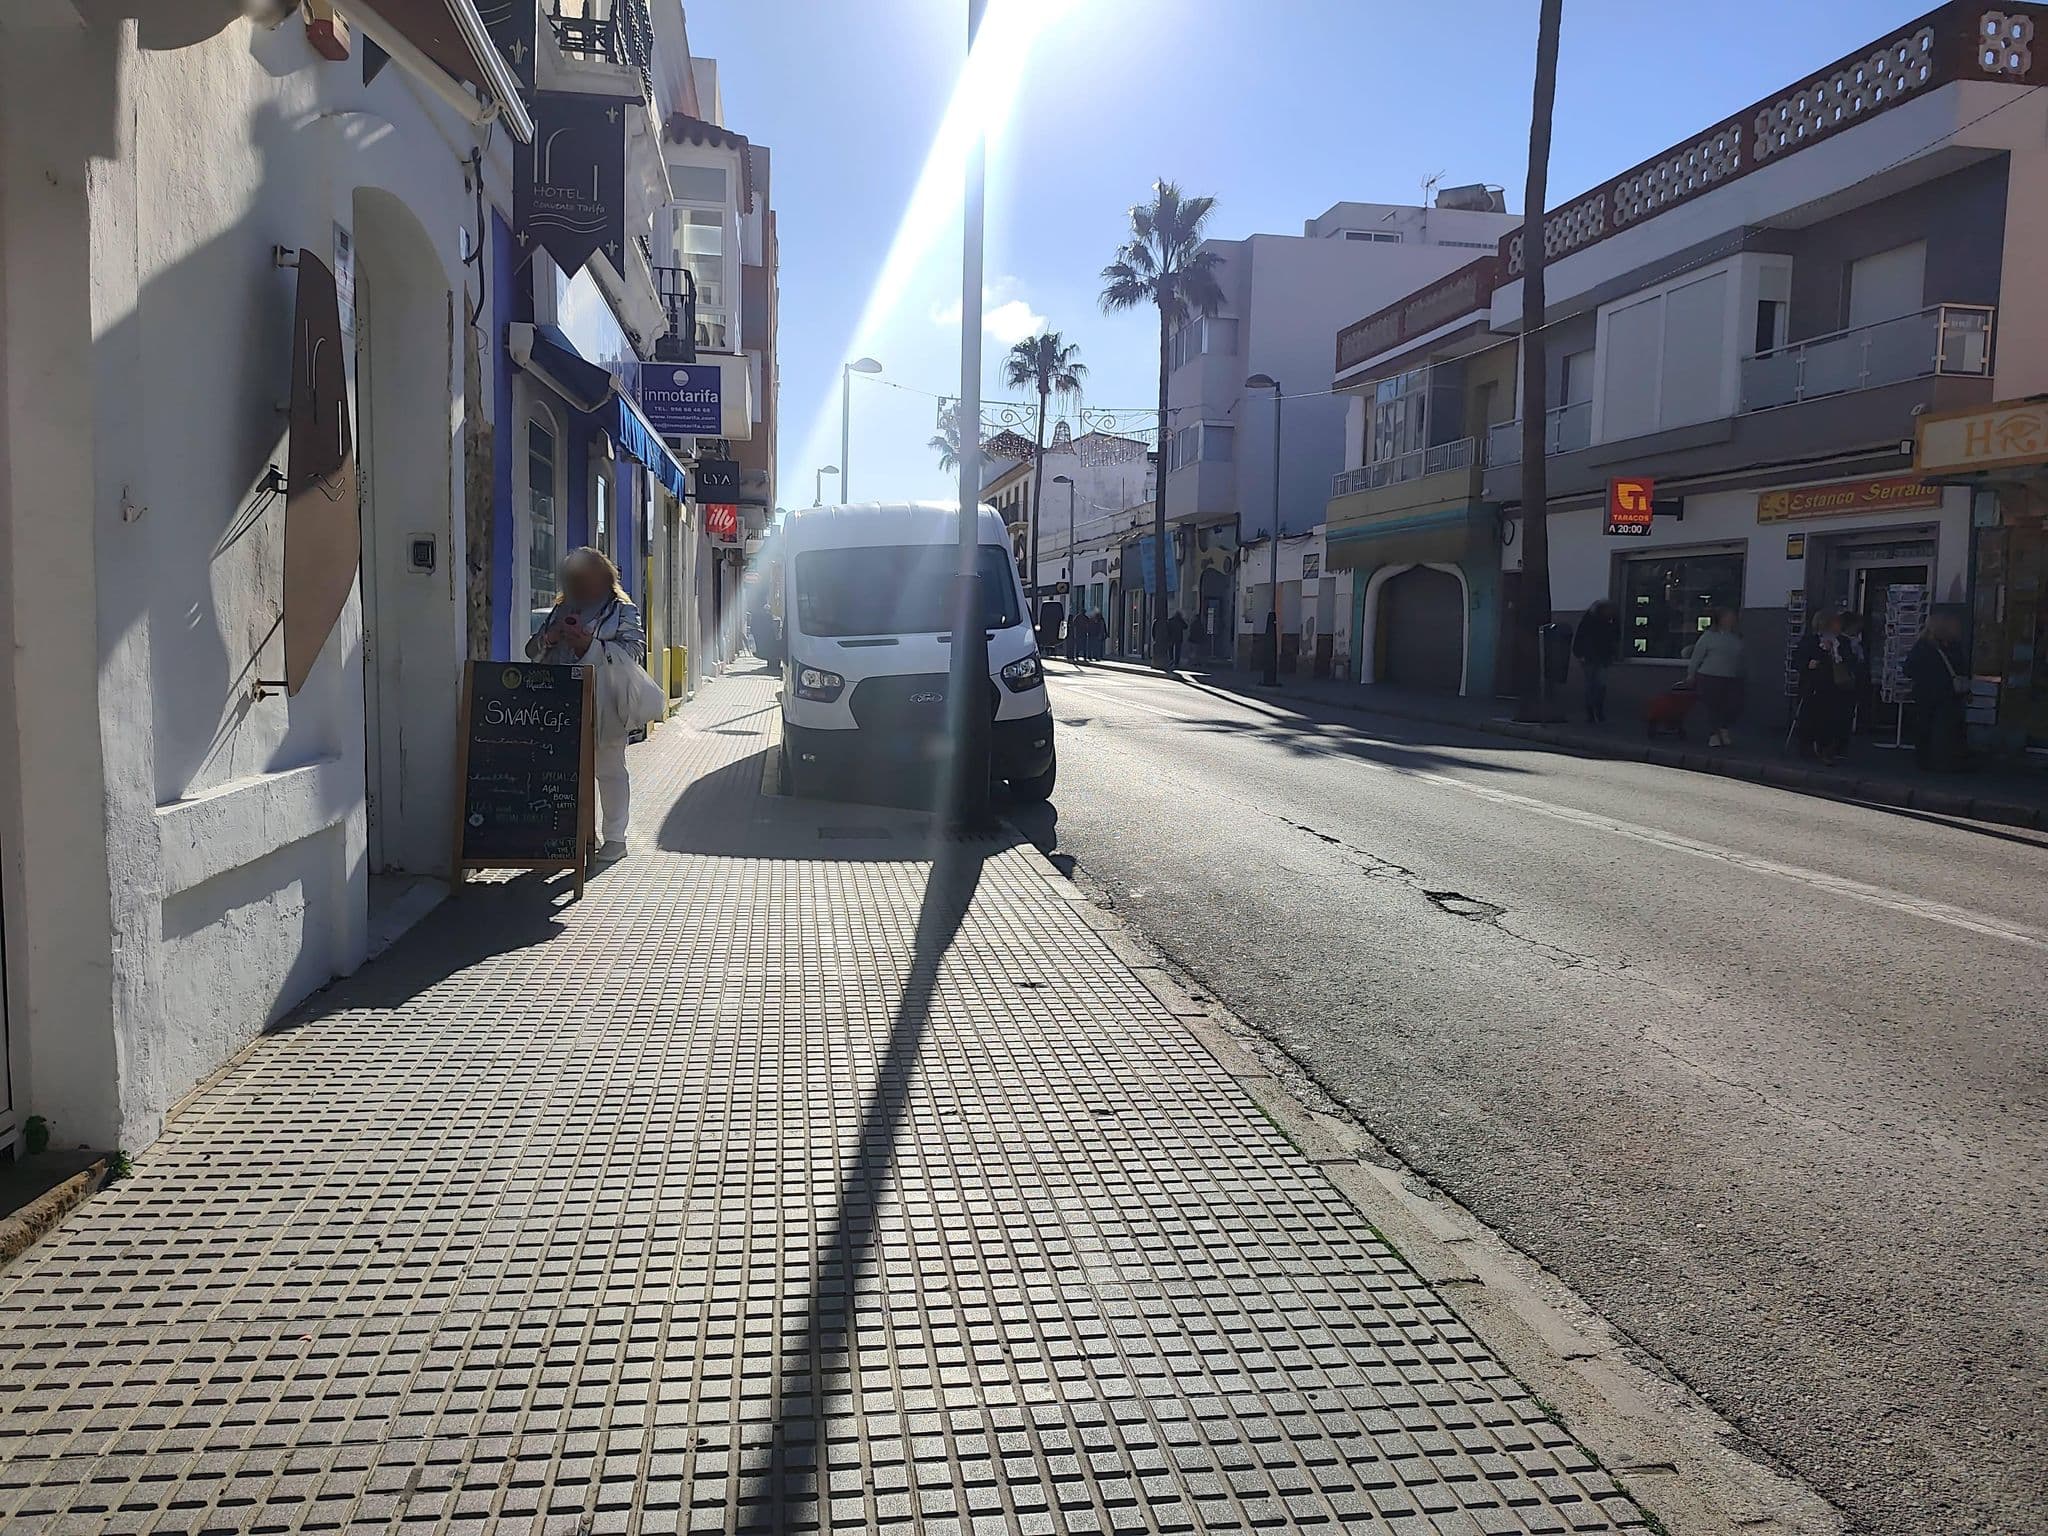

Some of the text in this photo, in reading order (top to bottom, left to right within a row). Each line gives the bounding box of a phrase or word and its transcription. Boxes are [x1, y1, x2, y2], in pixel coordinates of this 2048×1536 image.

[533, 185, 585, 200] HOTEL
[644, 387, 719, 403] inmotarifa
[1790, 482, 1937, 510] Estanco Serrano
[708, 507, 736, 531] illy
[1613, 514, 1649, 522] TABACOS
[1617, 524, 1642, 534] 20:00
